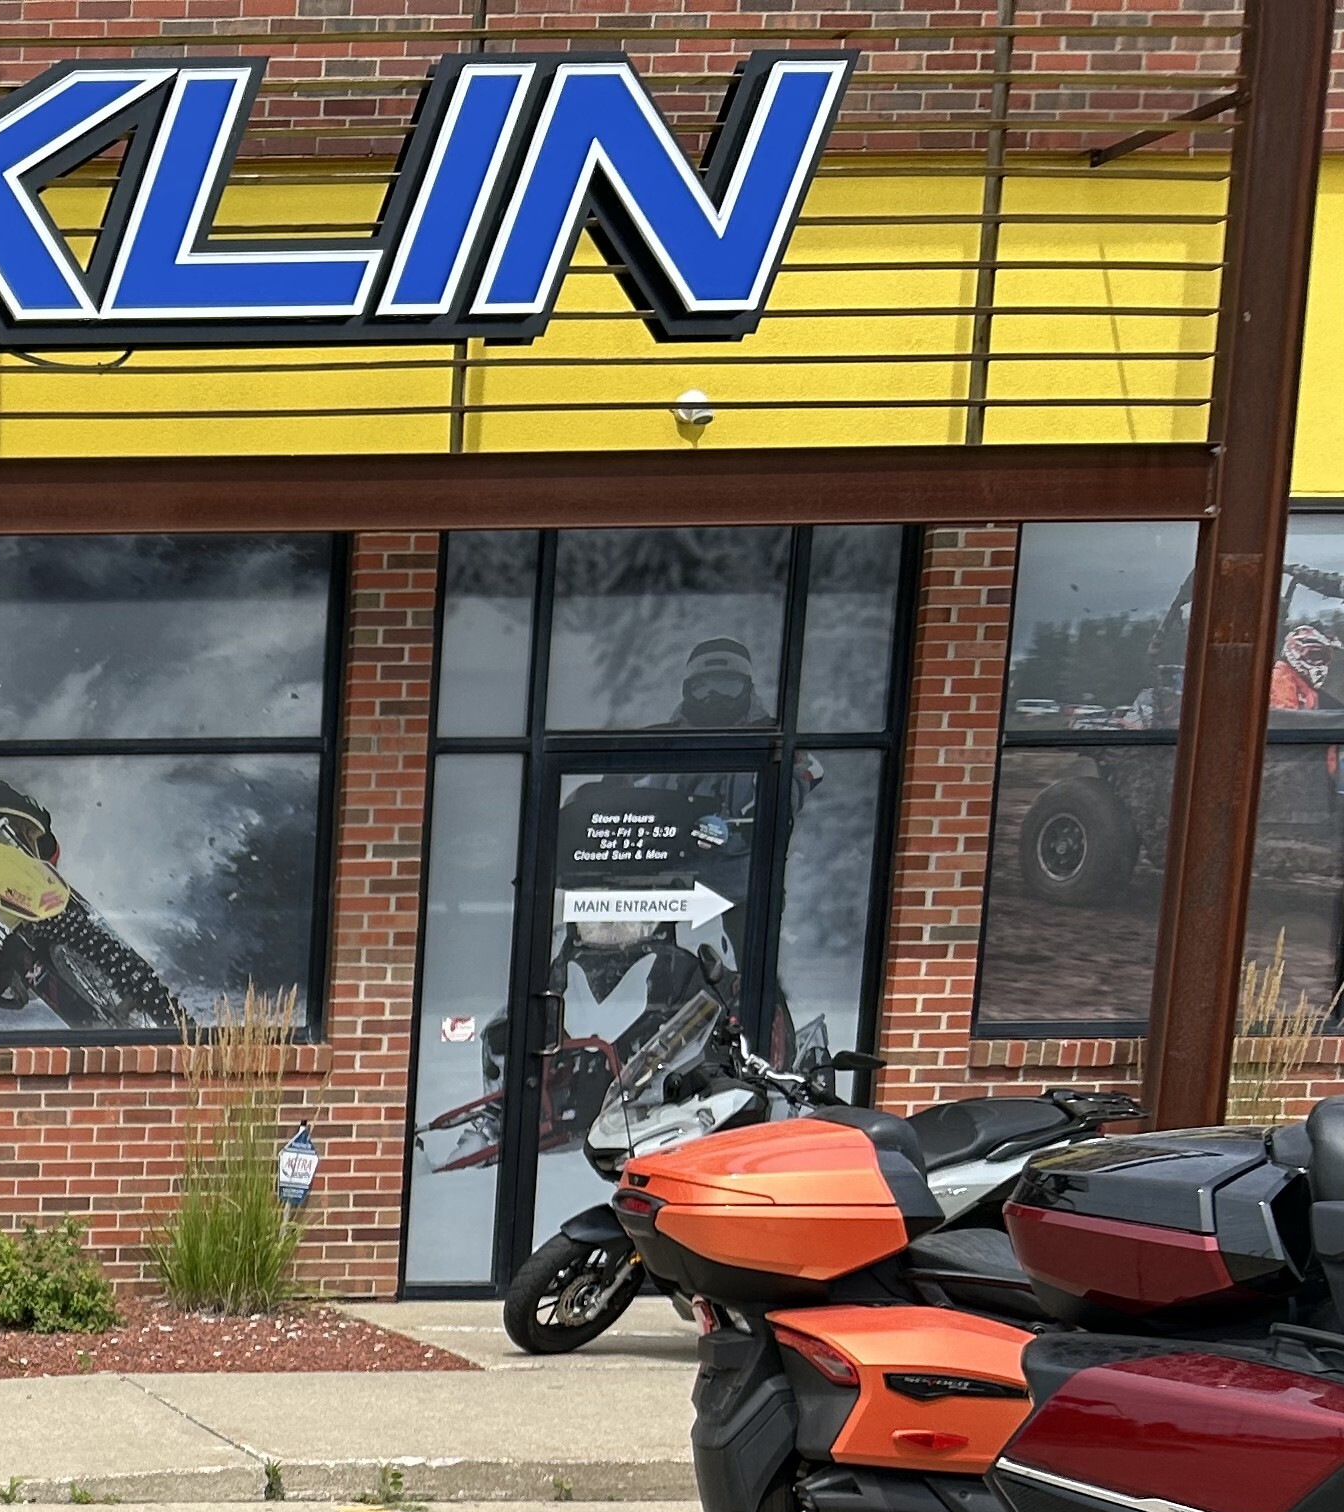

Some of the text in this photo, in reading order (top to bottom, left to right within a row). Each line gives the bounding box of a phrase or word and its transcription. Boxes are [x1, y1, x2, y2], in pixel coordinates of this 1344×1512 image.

[591, 813, 655, 824] Store Hours
[600, 839, 617, 850] Sat
[573, 850, 608, 861] Closed
[611, 850, 631, 860] Sun
[646, 850, 668, 860] Mon
[573, 899, 688, 913] MAIN ENTRANCE
